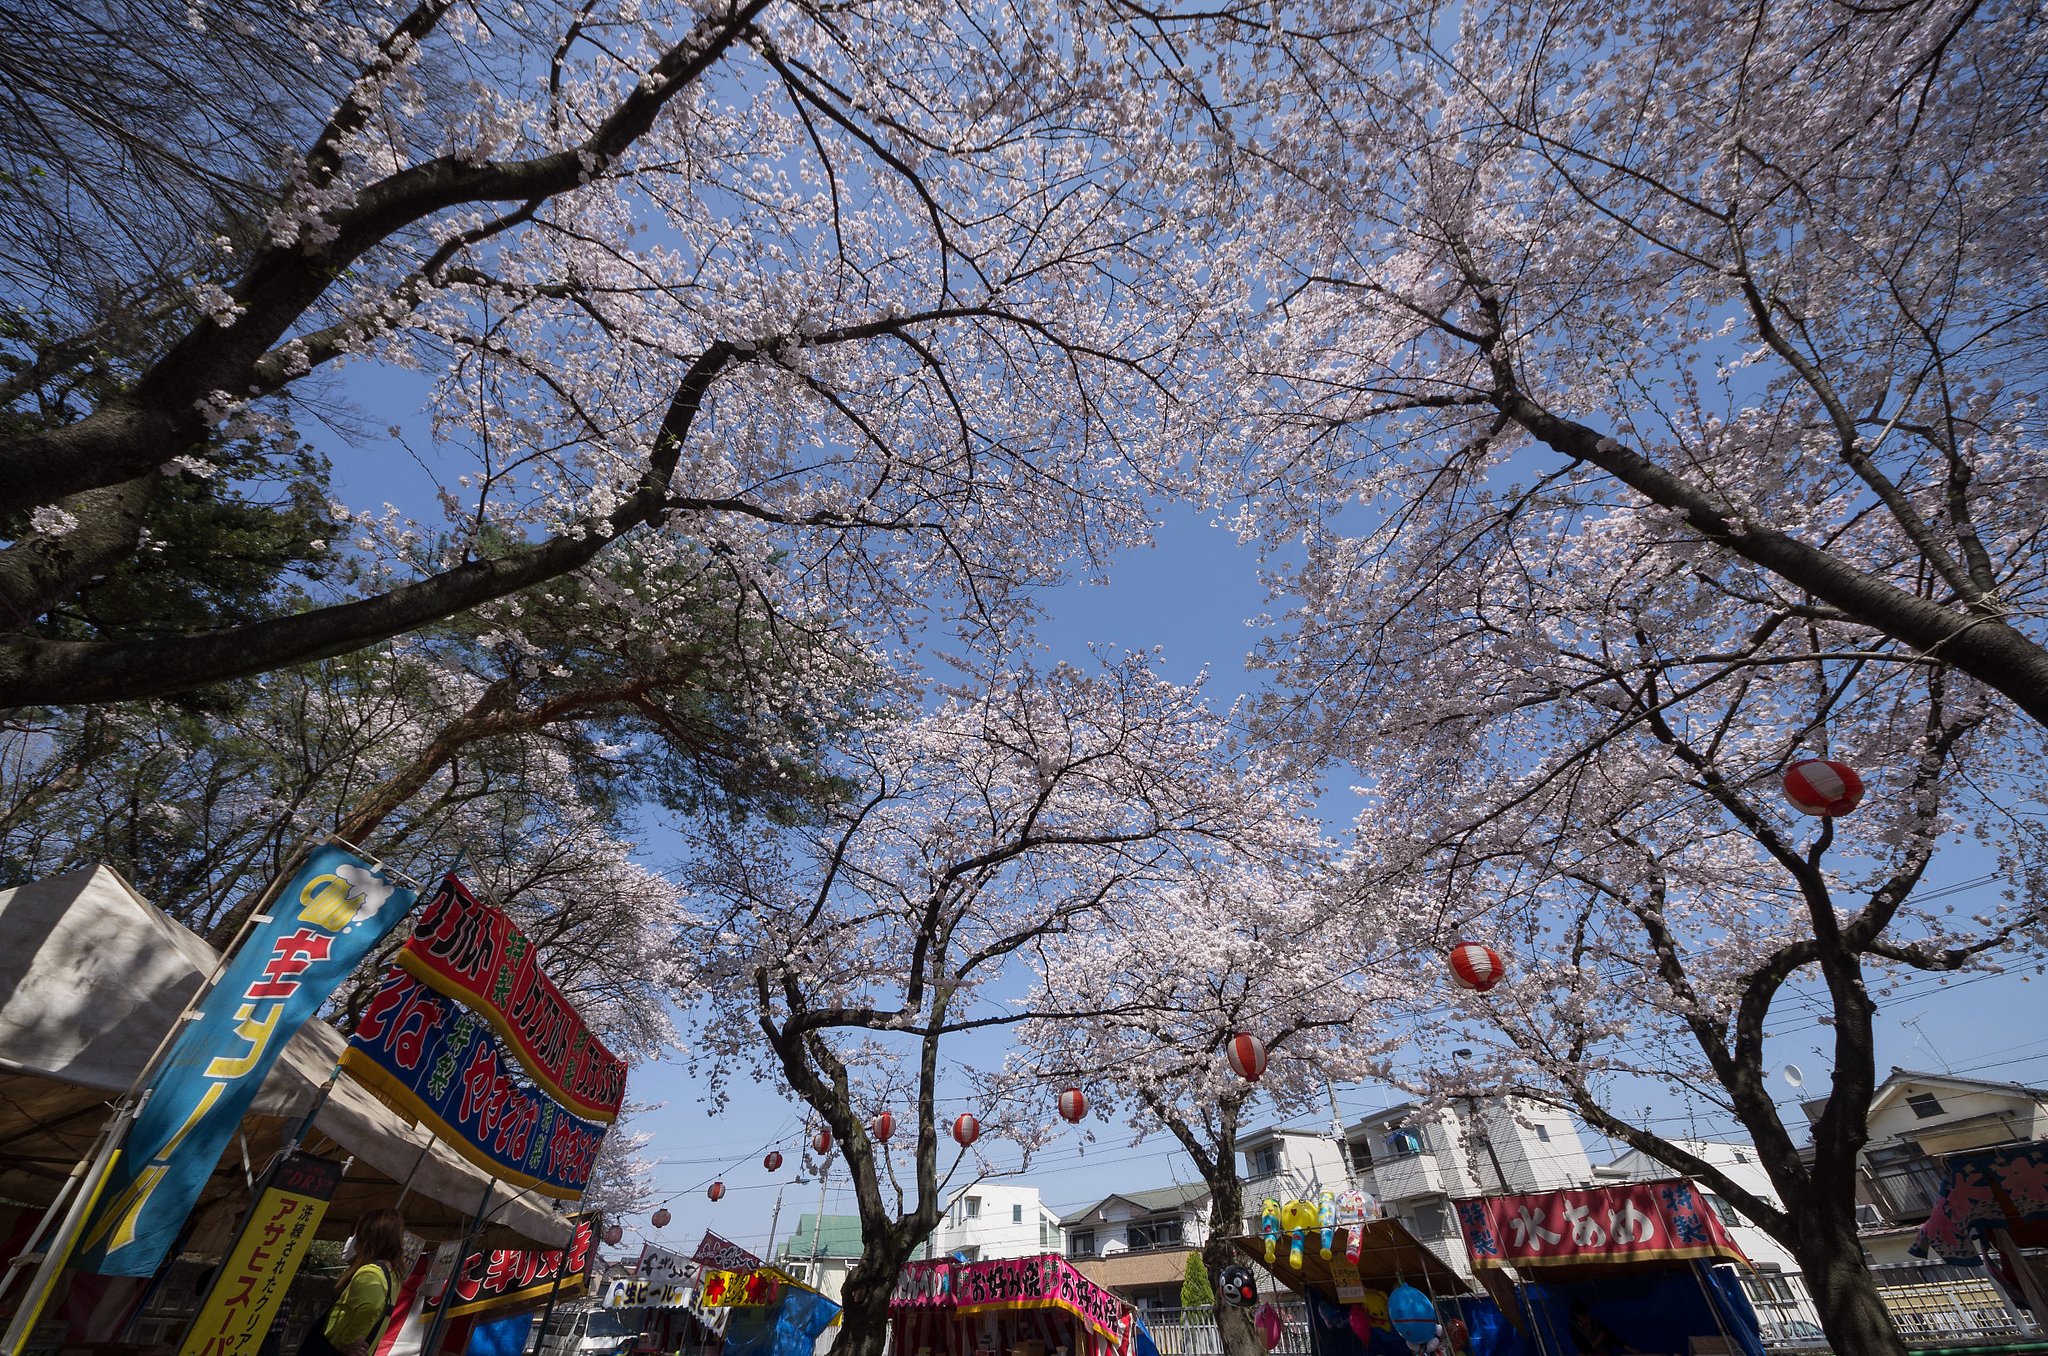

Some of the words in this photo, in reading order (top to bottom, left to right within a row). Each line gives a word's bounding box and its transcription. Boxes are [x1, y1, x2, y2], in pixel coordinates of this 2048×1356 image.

[493, 929, 527, 1009] 特製
[428, 1014, 475, 1100] 特製
[458, 1041, 538, 1161] やきそば
[1460, 1202, 1498, 1255] 特製
[1509, 1199, 1655, 1251] 水あめ
[1662, 1184, 1709, 1243] 特製
[230, 1204, 315, 1356] 洗練されたクリア
[623, 1281, 674, 1304] 生ビール
[971, 1261, 1042, 1303] お好み焼
[1061, 1270, 1118, 1333] お好み焼
